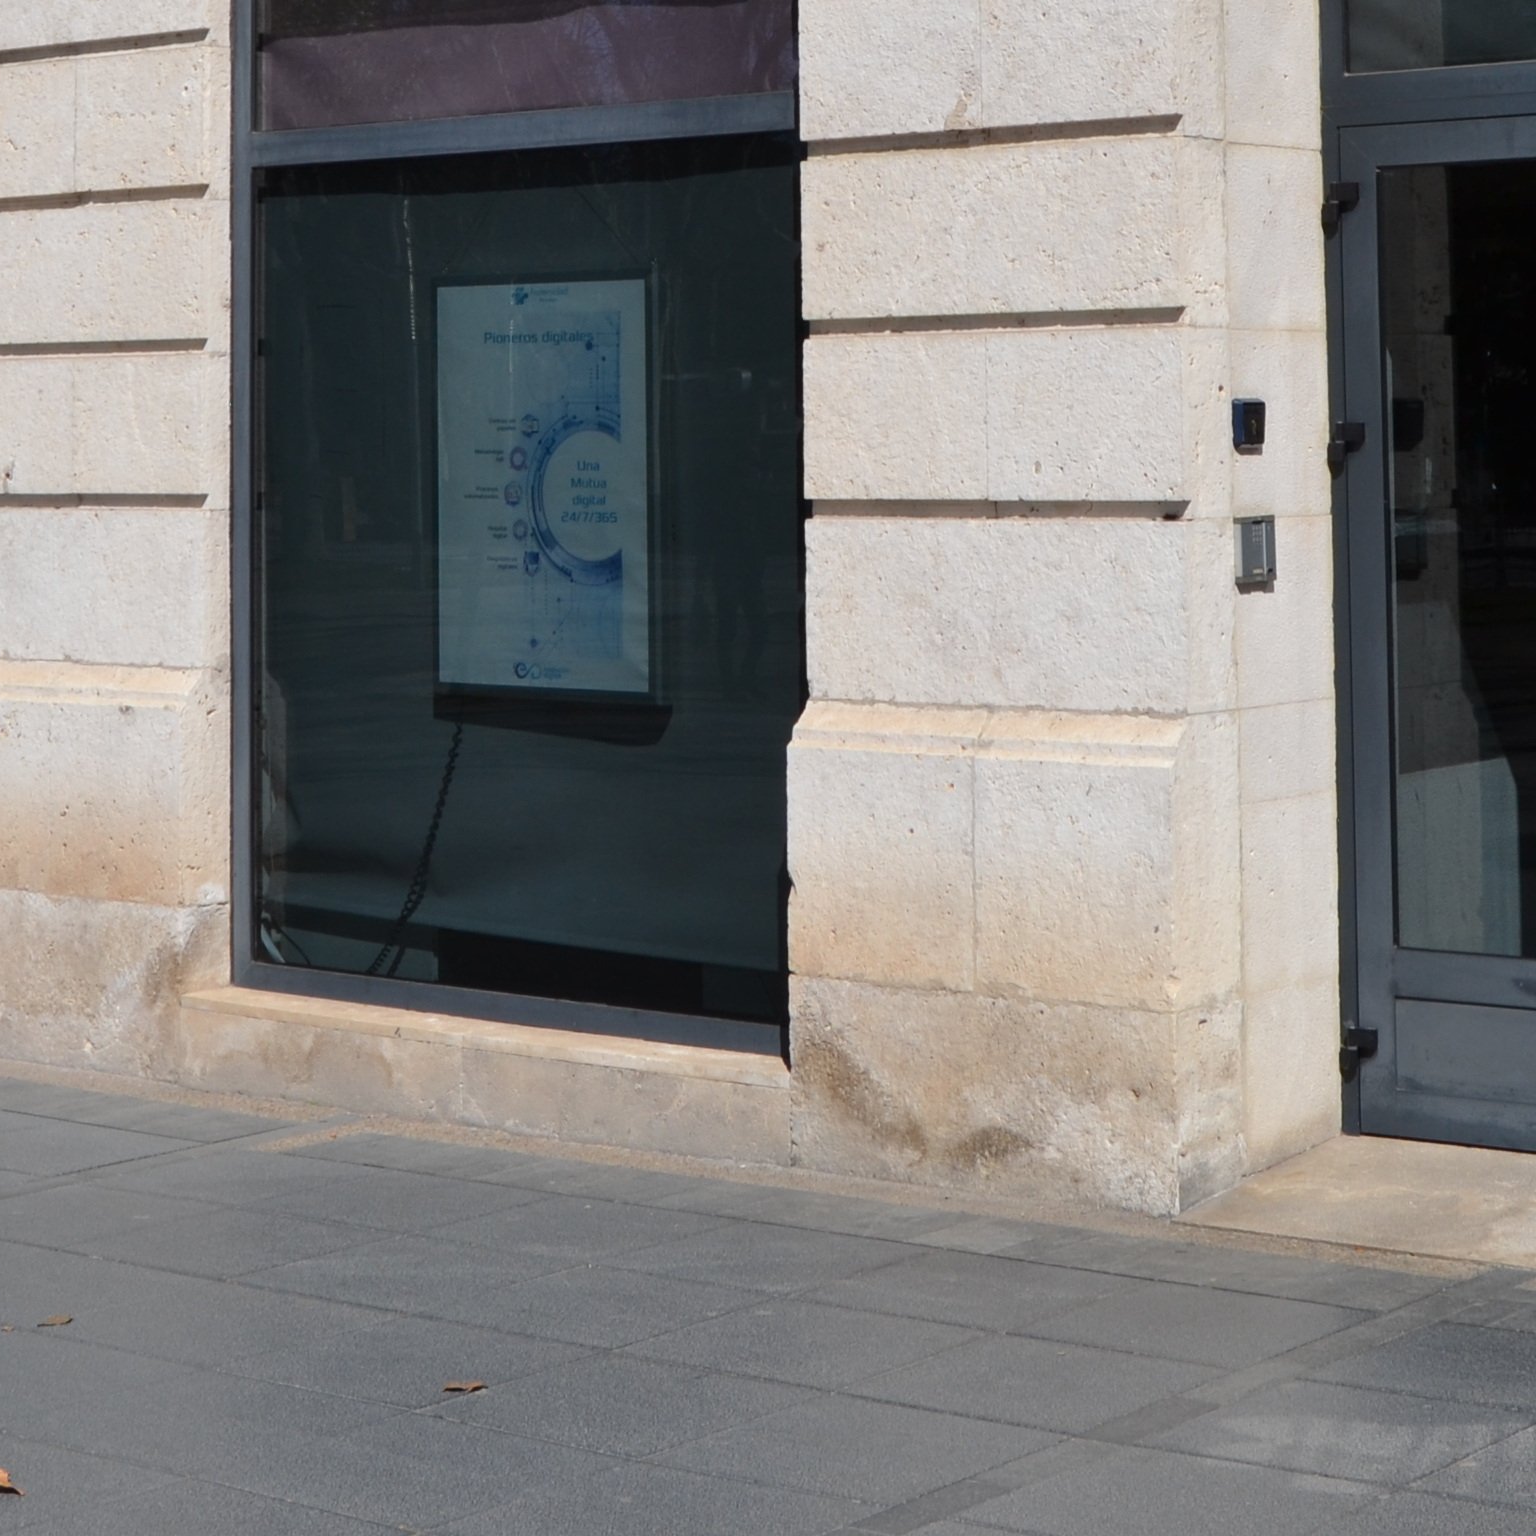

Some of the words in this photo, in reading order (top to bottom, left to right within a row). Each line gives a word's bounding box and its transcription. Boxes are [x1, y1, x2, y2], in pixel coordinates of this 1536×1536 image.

[483, 331, 538, 344] Pioneros
[542, 330, 595, 346] digitales
[576, 460, 600, 472] Una
[570, 477, 607, 489] Mutua
[572, 494, 606, 509] digital
[561, 511, 618, 524] 24/7/365
